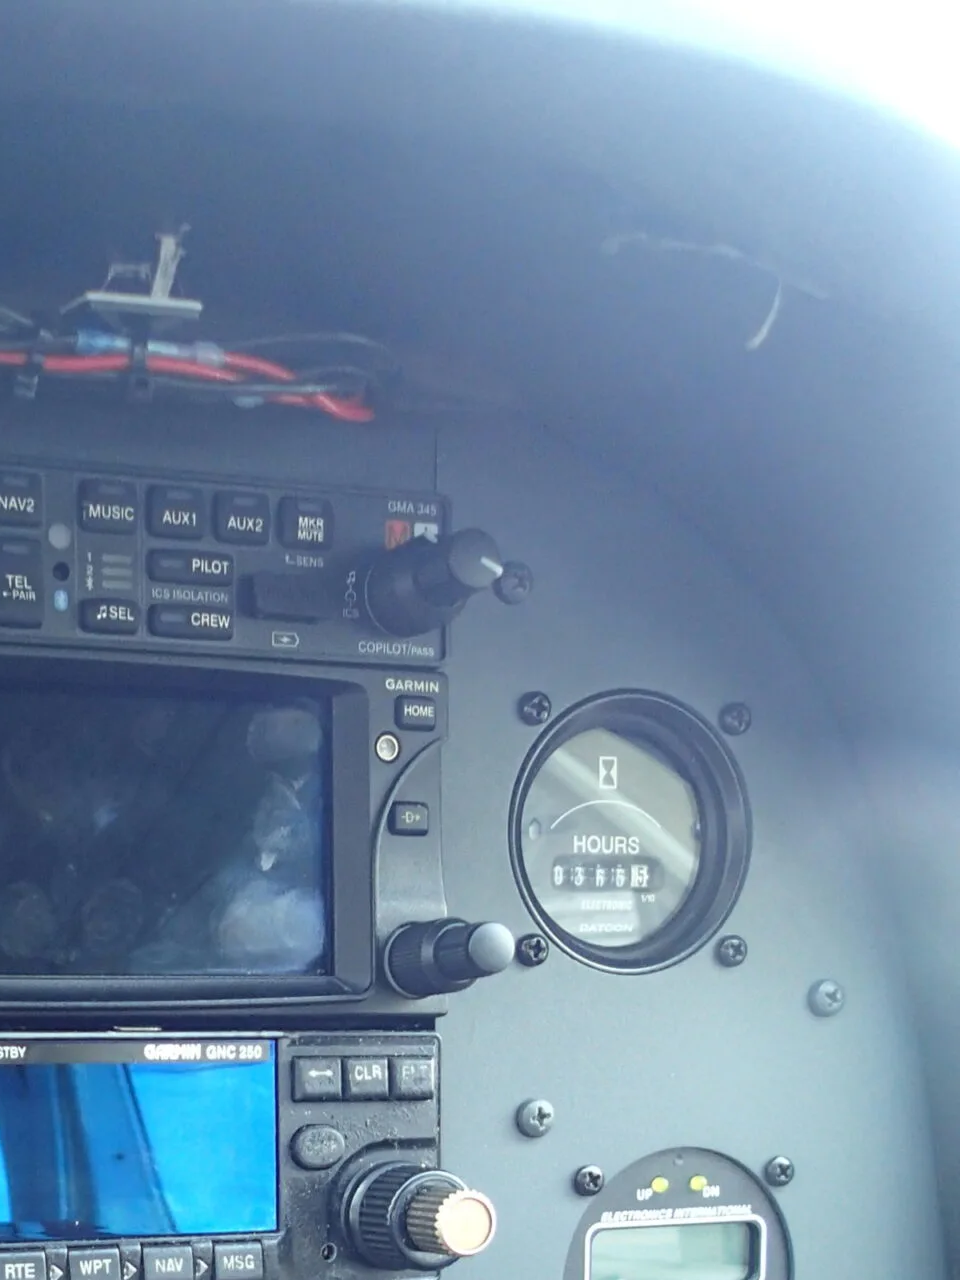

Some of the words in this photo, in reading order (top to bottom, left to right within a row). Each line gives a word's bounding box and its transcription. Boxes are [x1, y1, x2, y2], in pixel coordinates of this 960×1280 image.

[89, 503, 134, 521] MUSIC
[388, 501, 414, 514] GMA
[417, 503, 437, 516] 345
[162, 511, 197, 526] AUX1
[227, 516, 263, 533] AUX2
[298, 516, 324, 529] MKR
[298, 529, 323, 542] MUTE
[191, 558, 229, 575] PILOT
[6, 574, 31, 590] TEL
[151, 587, 169, 600] ICS
[172, 588, 229, 603] ISOLATION
[109, 605, 134, 622] SEL
[191, 613, 230, 629] CREW
[358, 640, 434, 657] COPILOT/PASS
[385, 678, 439, 693] GARMIN
[404, 705, 434, 718] HOME
[573, 835, 640, 855] HOURS
[206, 1045, 237, 1060] GNC
[239, 1044, 262, 1060] 250
[354, 1065, 382, 1081] CLR
[636, 1188, 653, 1201] UP
[80, 1257, 112, 1276] WPT
[155, 1257, 184, 1274] NAV
[223, 1254, 255, 1271] MSG
[4, 1264, 36, 1280] RTE
